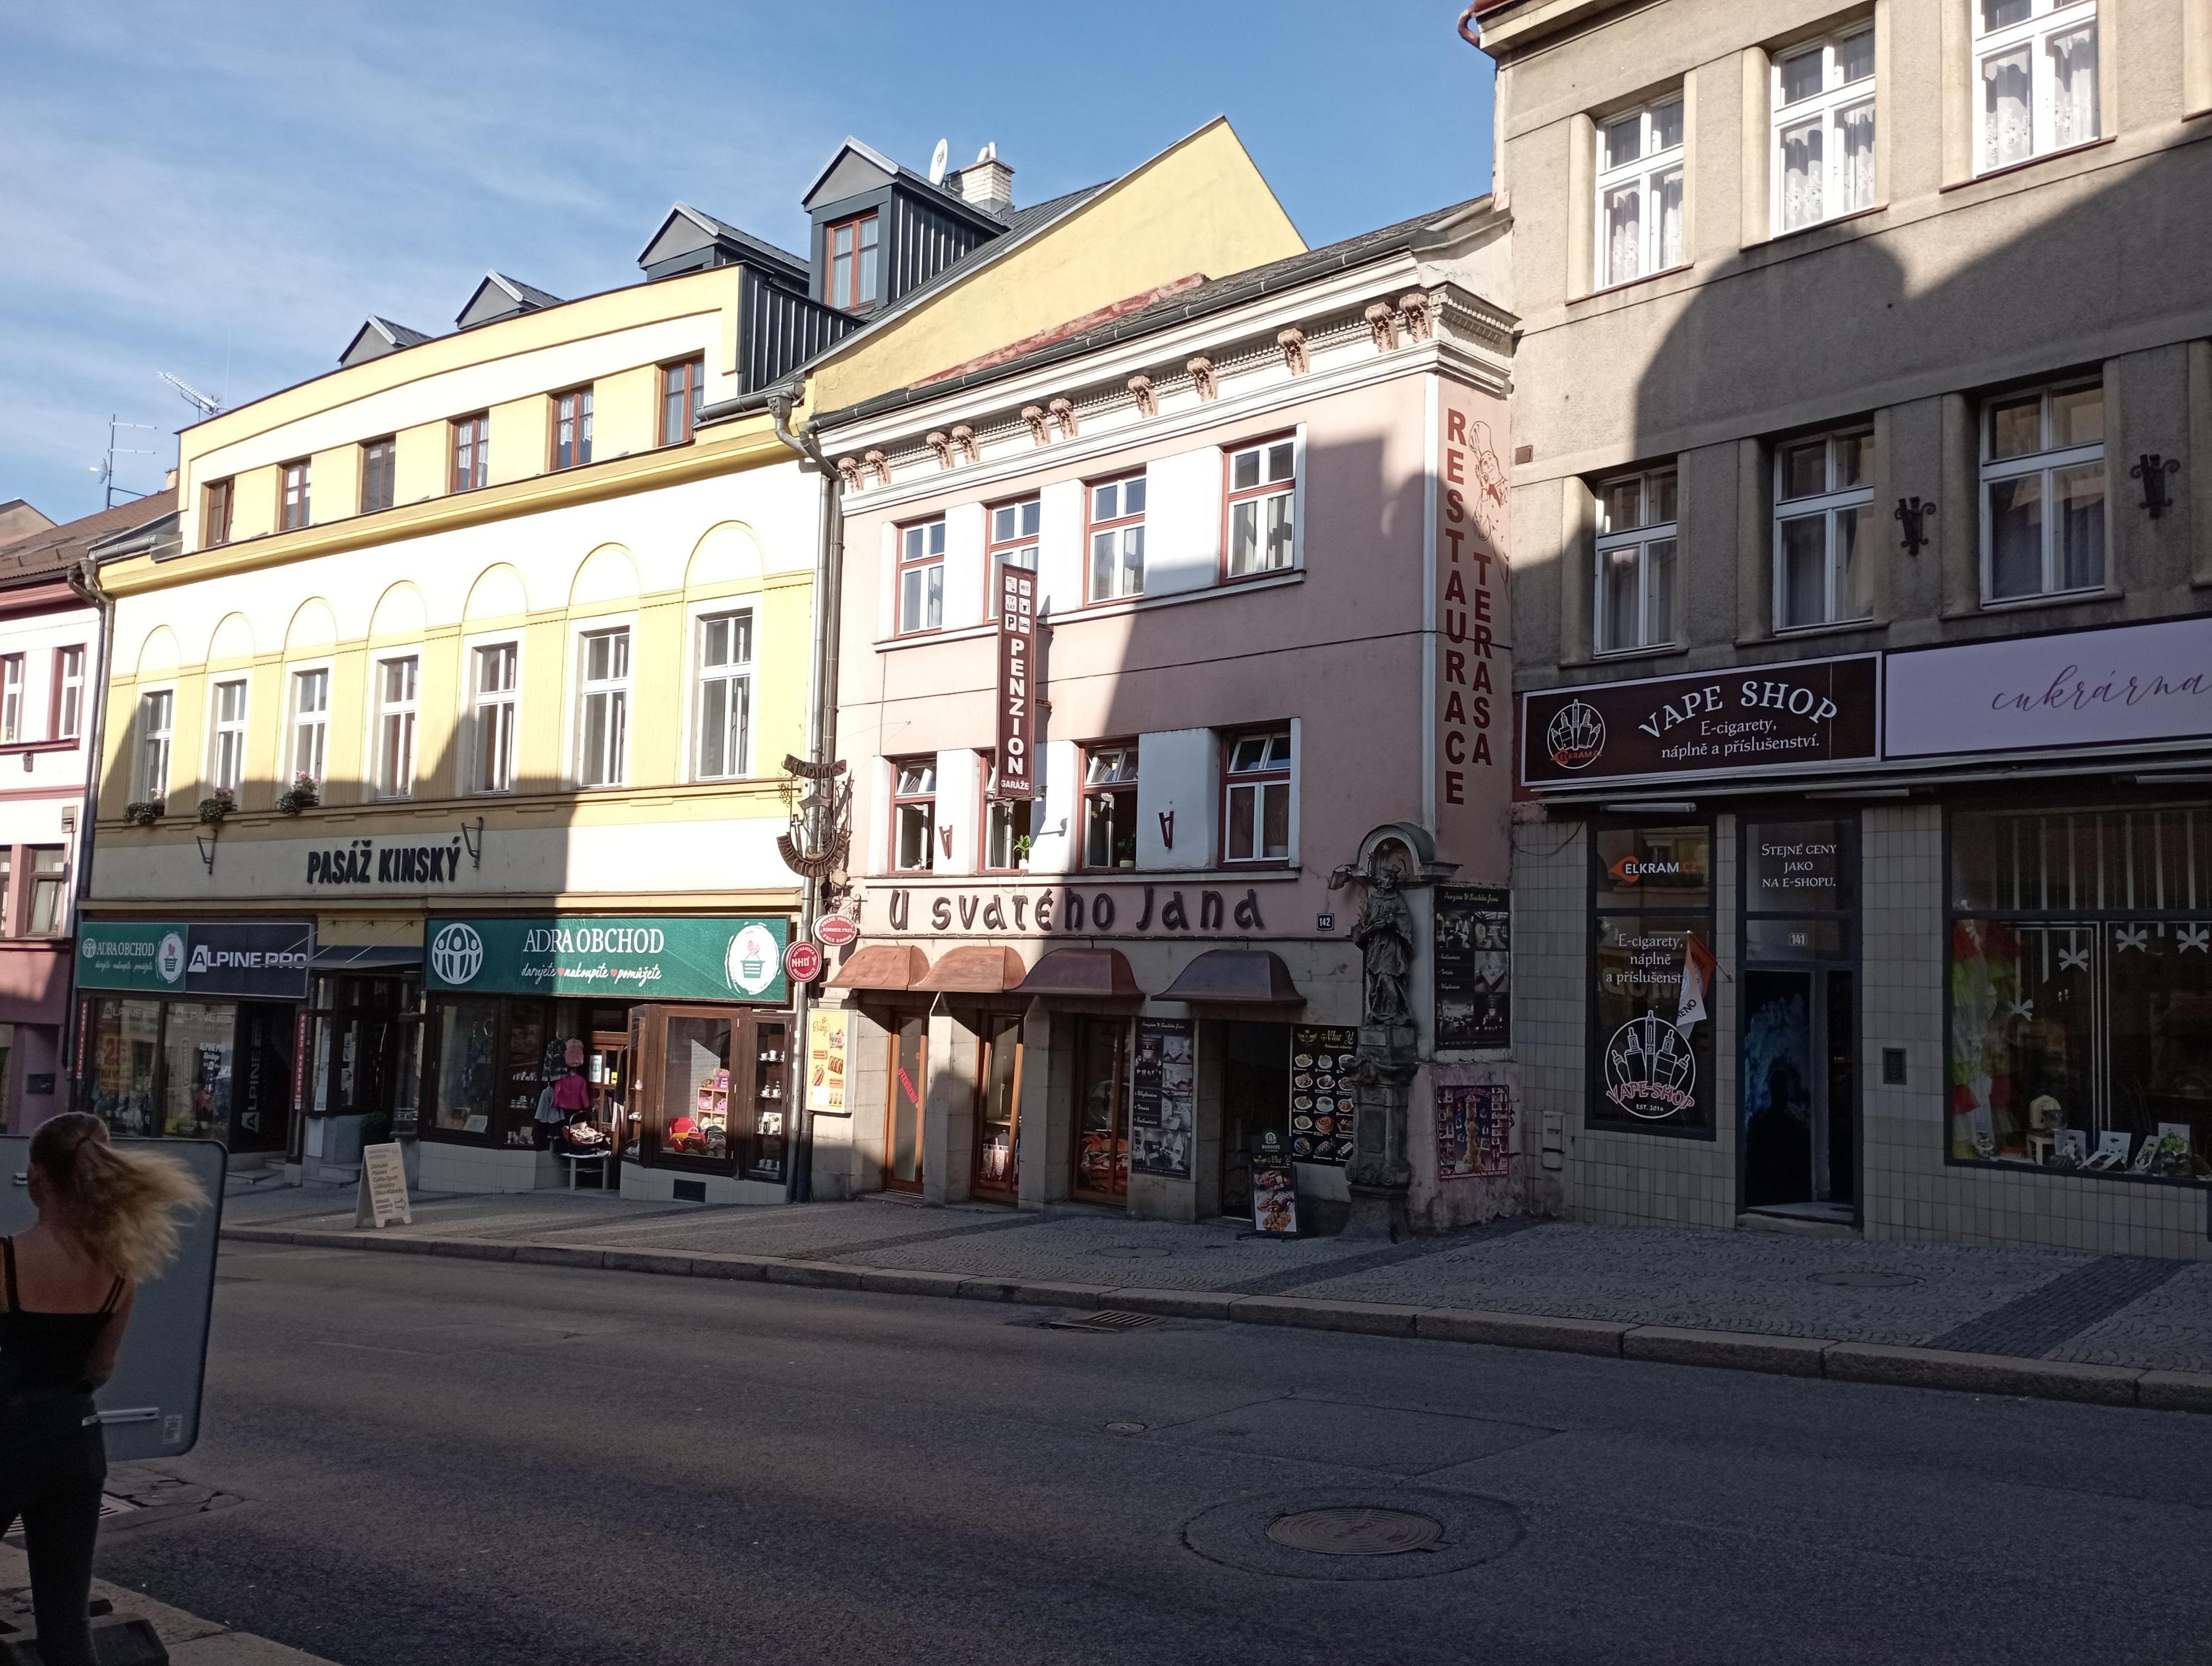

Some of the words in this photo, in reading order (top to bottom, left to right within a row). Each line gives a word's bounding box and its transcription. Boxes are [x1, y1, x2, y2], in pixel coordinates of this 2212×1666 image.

[1444, 408, 1467, 805] RESTAURACE
[1008, 616, 1014, 628] P
[1472, 553, 1492, 766] TERASA
[1992, 665, 2212, 711] cukrárna
[1008, 638, 1025, 775] PENZION
[1638, 685, 1723, 739] VAPE
[1741, 681, 1837, 724] SHOP
[1700, 717, 1777, 737] E-cigarety,
[1661, 741, 1708, 760] náplně
[1711, 744, 1719, 754] a
[1725, 733, 1819, 759] příslušenství.
[1001, 779, 1029, 790] GARÁŽE
[1762, 844, 1803, 857] STEJNÉ
[1806, 844, 1837, 855] CENY
[307, 840, 372, 884] PASÁŽ
[378, 836, 460, 883] KINSKÝ
[1625, 861, 1697, 875] ELKRAM.CZ
[1784, 861, 1813, 874] JAKO
[1762, 878, 1779, 887] NA
[1782, 877, 1837, 887] E-SHOPU.
[889, 890, 909, 930] U
[1136, 886, 1264, 930] Jana
[1319, 917, 1330, 926] 142
[522, 929, 575, 953] ADRA
[576, 928, 664, 954] OBCHOD
[836, 935, 852, 943] ROOMS
[1618, 934, 1683, 950] E-cigarety,
[1791, 934, 1805, 945] 141
[97, 942, 118, 955] ADRA
[118, 942, 154, 956] OBCHOD
[188, 945, 262, 972] ALPINE
[1630, 951, 1671, 967] náplně
[521, 962, 556, 985] darujete
[615, 964, 662, 987] pomůžete
[1617, 969, 1683, 985] příslušenst
[1606, 1081, 1650, 1104] VAPE
[1651, 1082, 1695, 1110] SHOP
